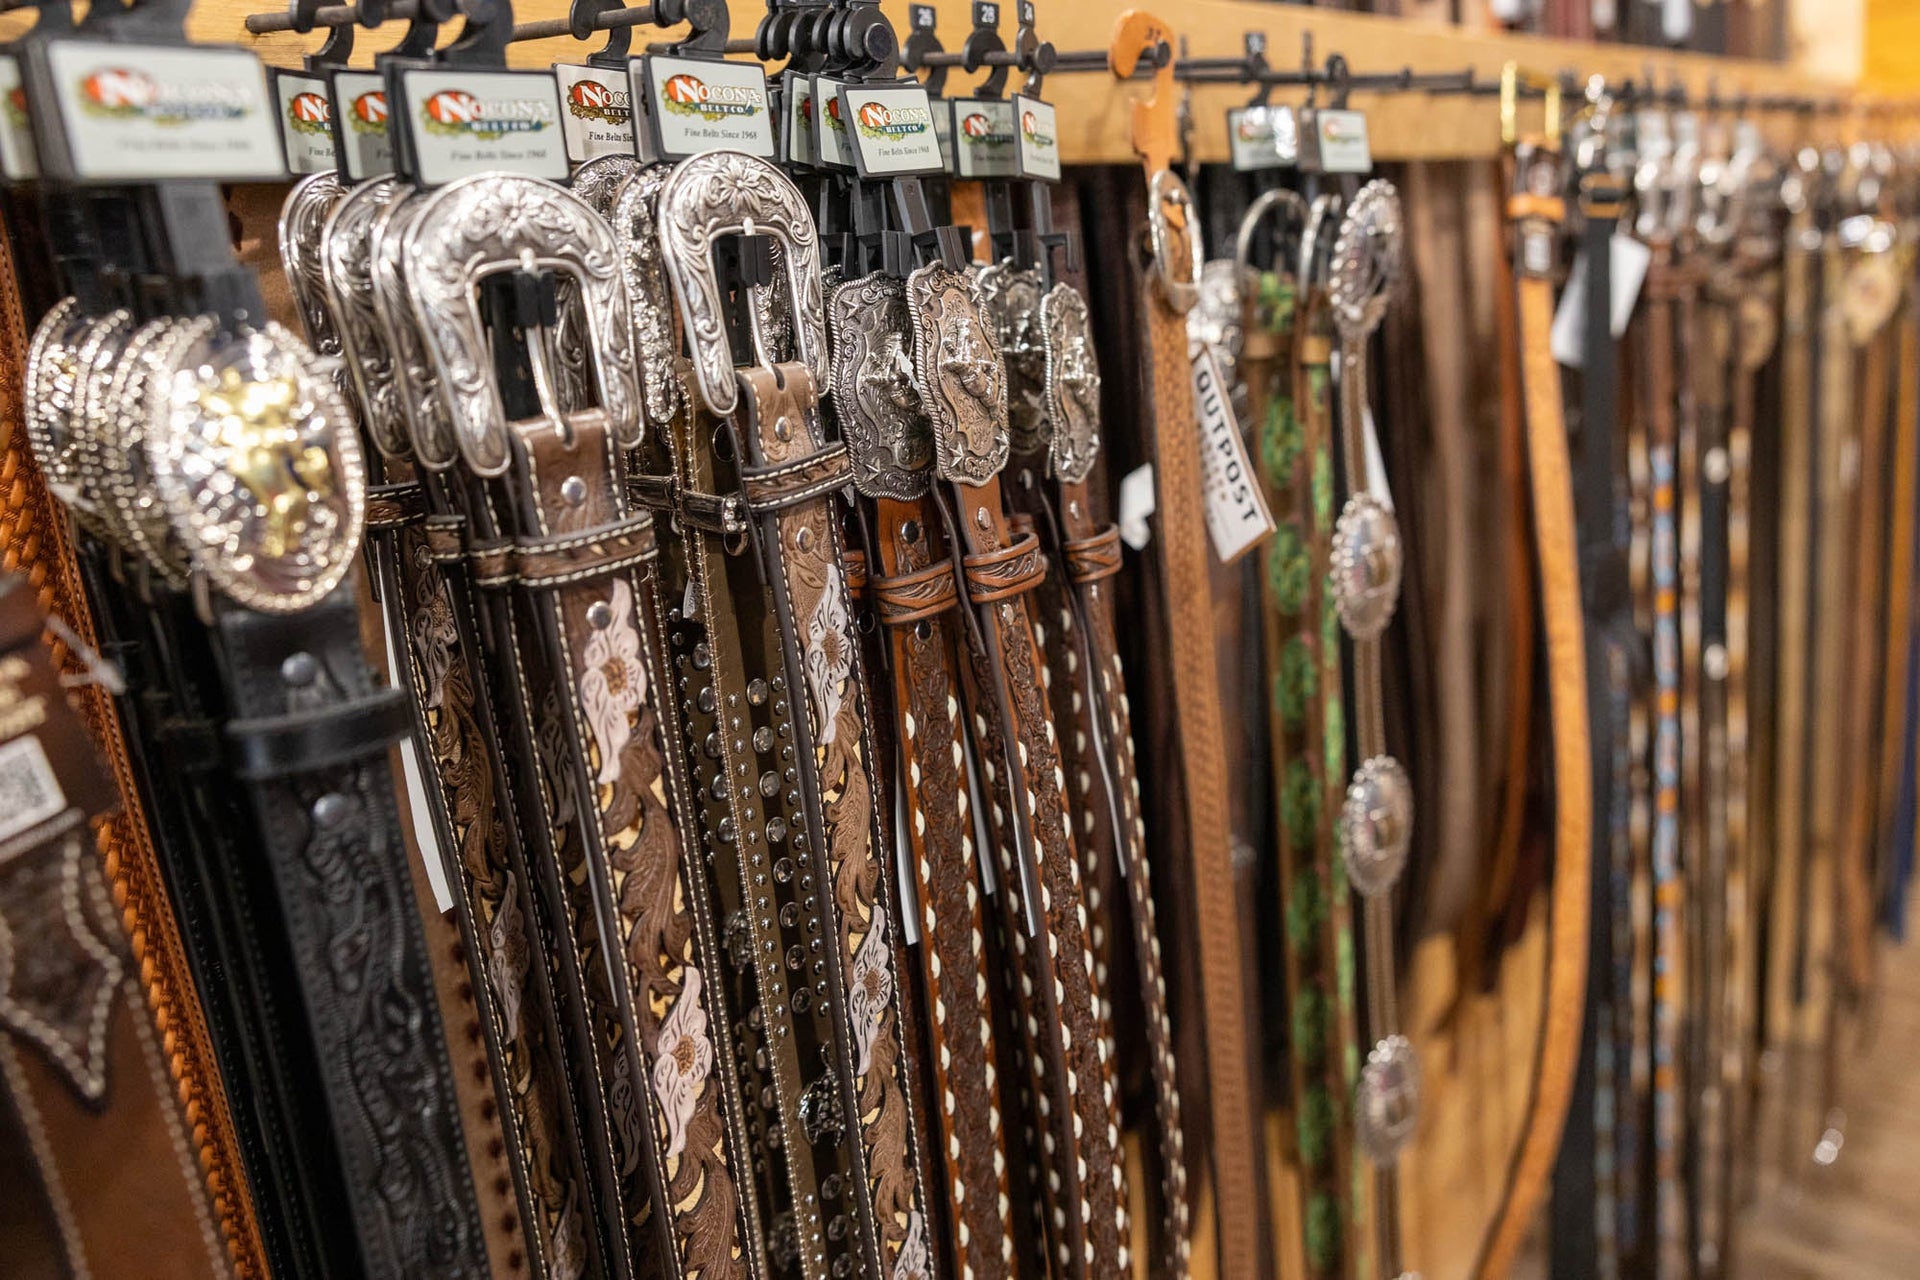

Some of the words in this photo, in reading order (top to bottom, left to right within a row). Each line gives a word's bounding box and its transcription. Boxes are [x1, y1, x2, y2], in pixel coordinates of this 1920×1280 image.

[580, 85, 630, 108] NOCO
[674, 78, 761, 110] NOCONA
[865, 106, 929, 128] NOCONA
[588, 131, 604, 141] Fine
[1197, 370, 1258, 522] OUTPOST
